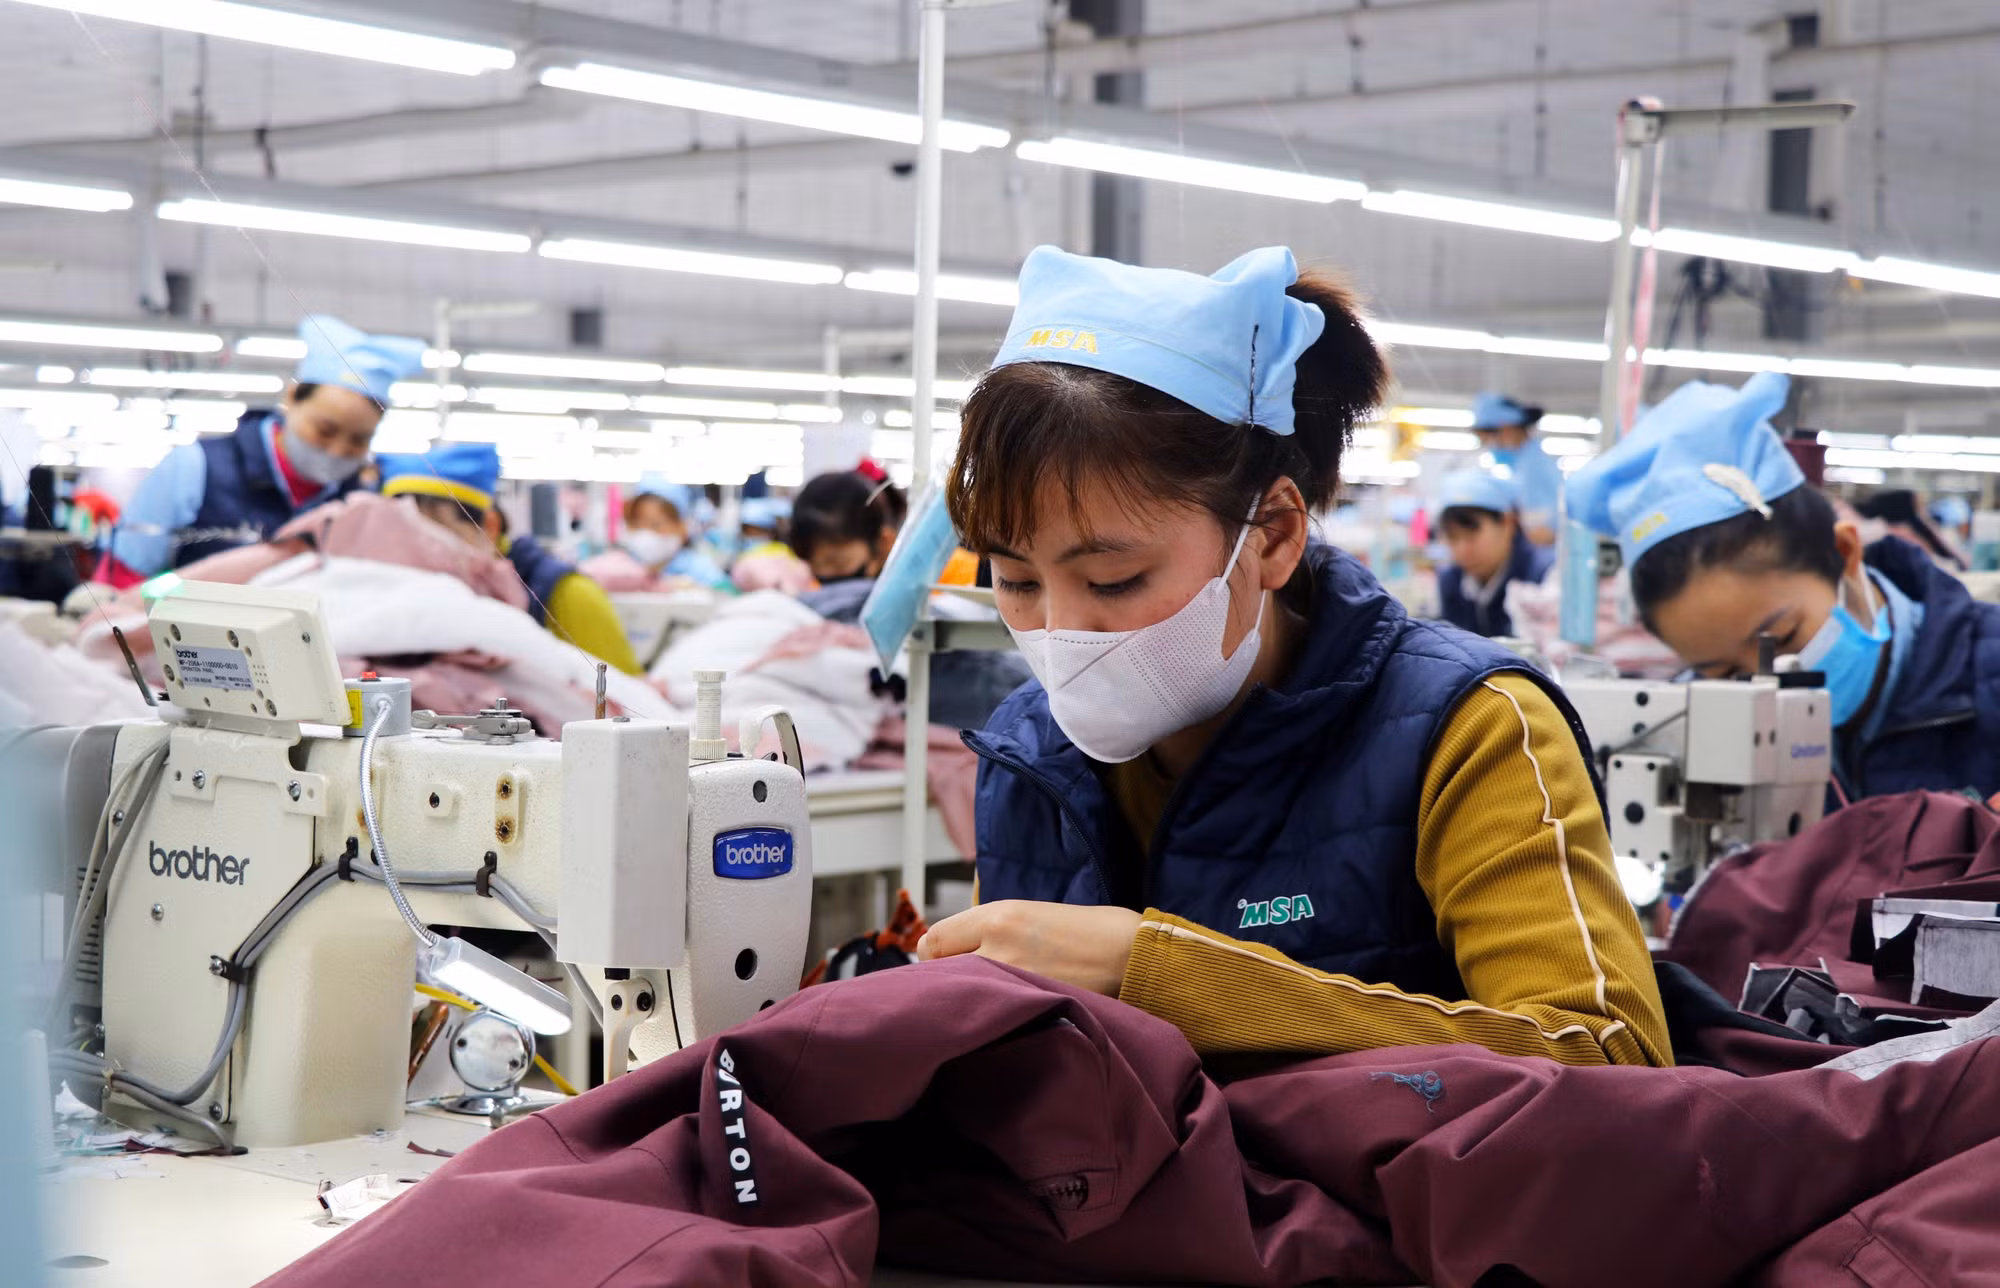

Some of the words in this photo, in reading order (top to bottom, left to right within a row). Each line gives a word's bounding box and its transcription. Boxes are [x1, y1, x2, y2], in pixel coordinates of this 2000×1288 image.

[1024, 329, 1099, 354] MSA
[176, 649, 198, 659] brother
[149, 840, 250, 885] brother
[726, 843, 786, 865] brother
[1238, 894, 1315, 928] MSA
